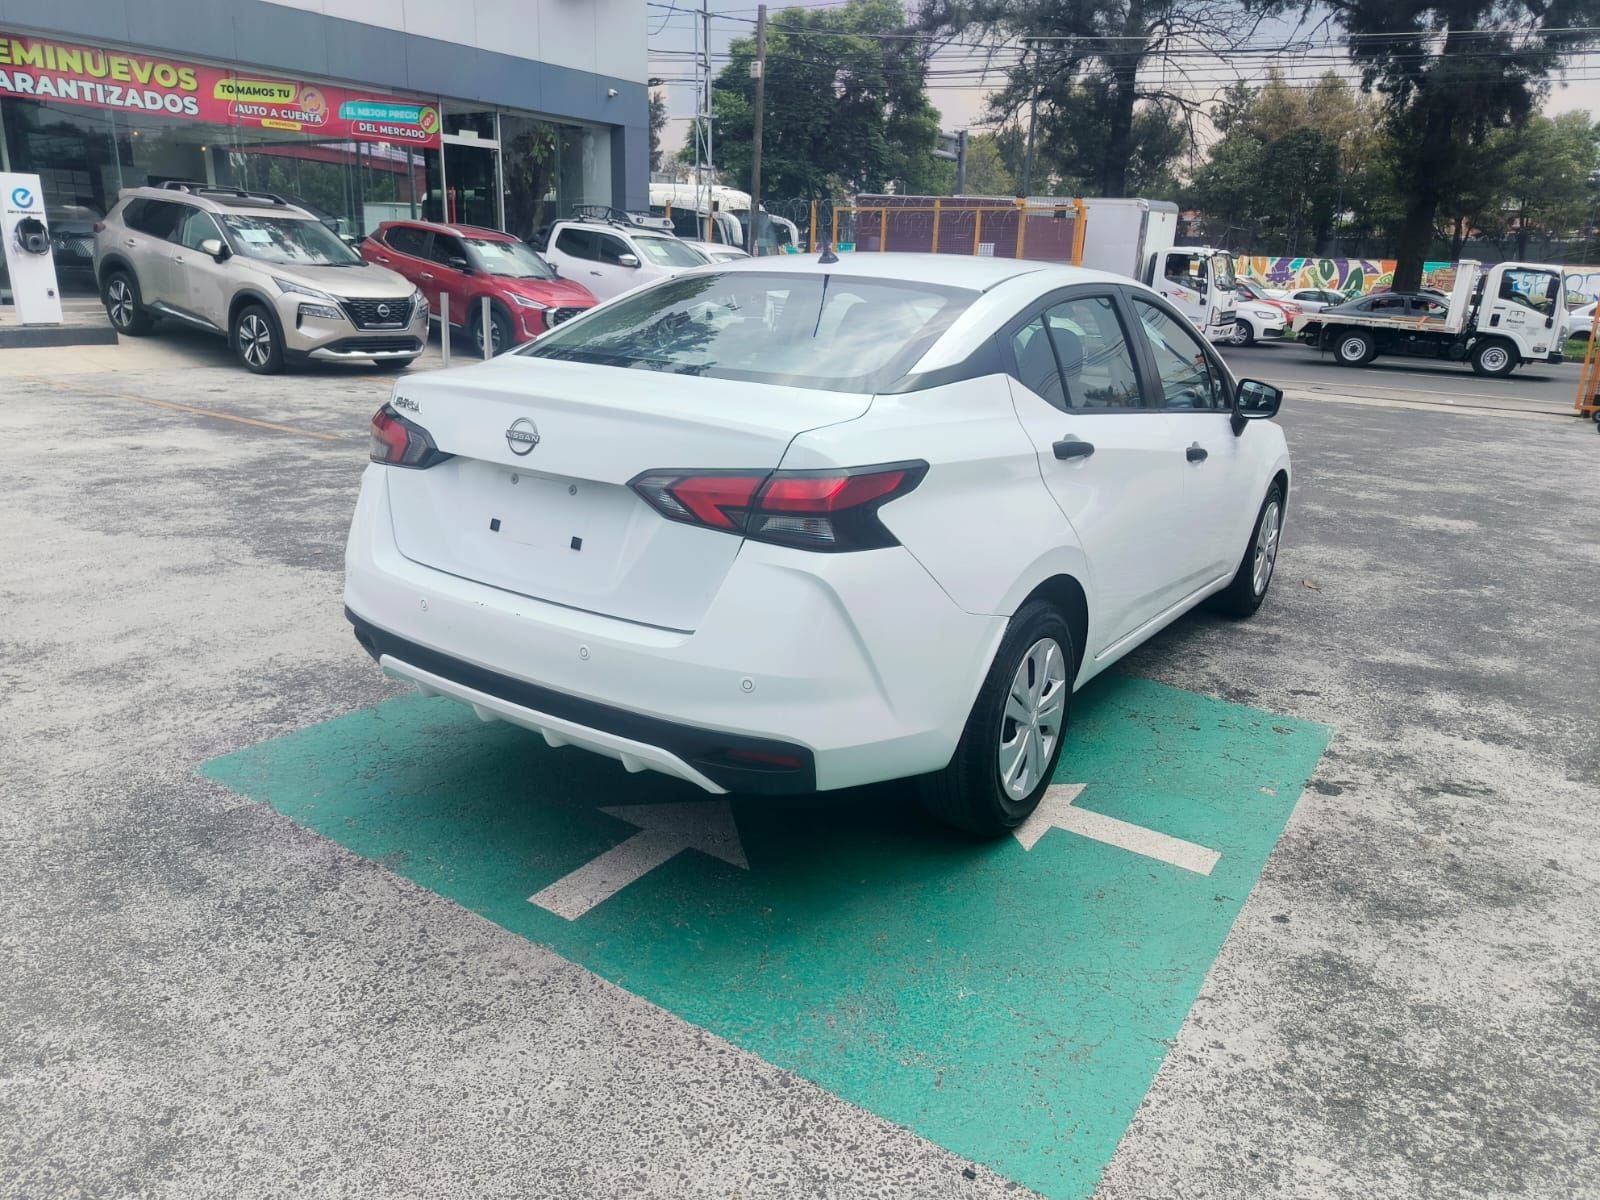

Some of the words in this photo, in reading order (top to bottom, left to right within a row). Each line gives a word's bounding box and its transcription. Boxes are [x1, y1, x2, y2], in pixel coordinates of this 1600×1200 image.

[220, 84, 275, 97] TOMAMOS
[277, 89, 290, 98] TU
[235, 104, 267, 116] AUTO
[270, 108, 278, 117] A
[281, 109, 323, 123] CUENTA
[388, 110, 418, 119] PRECIO
[359, 122, 377, 132] DEL
[380, 126, 425, 138] MERCADO
[506, 430, 540, 443] NISSAN
